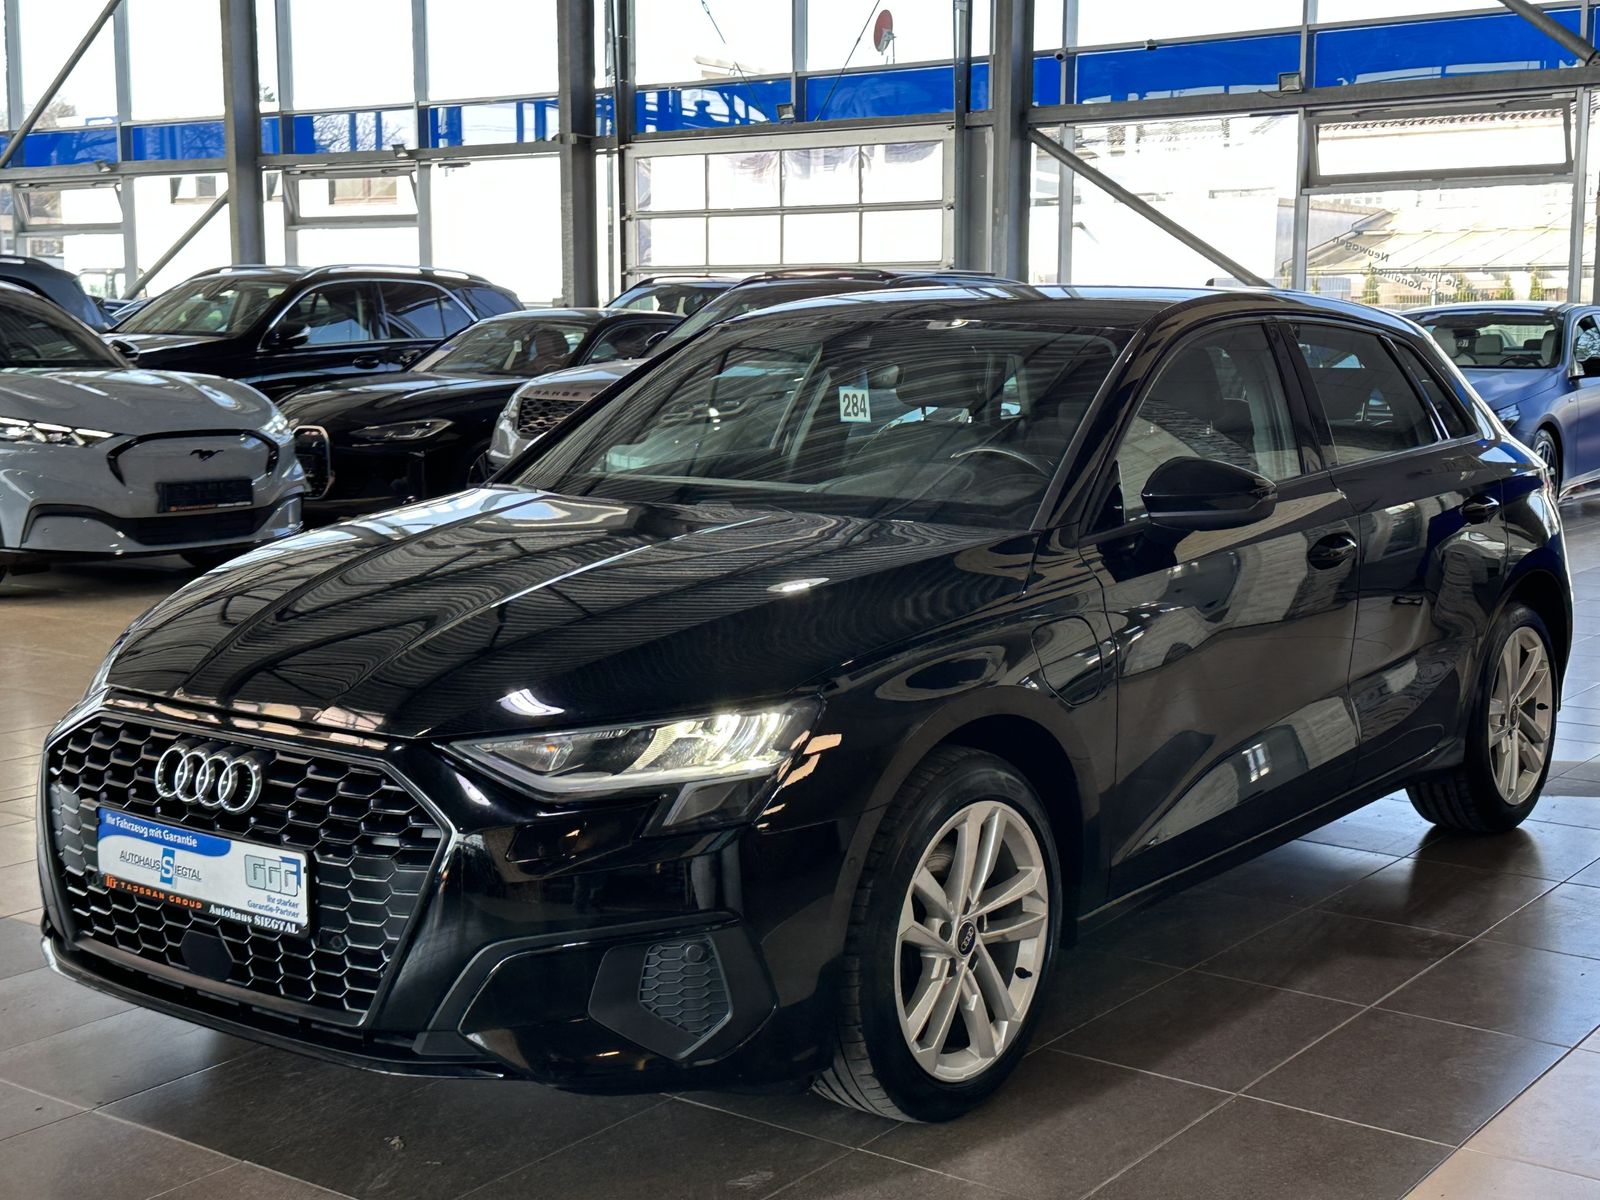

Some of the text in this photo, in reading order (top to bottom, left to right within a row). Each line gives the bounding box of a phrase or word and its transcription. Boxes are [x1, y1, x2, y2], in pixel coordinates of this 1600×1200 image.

[843, 393, 867, 417] 284
[116, 817, 148, 838] Fahrzeug
[149, 827, 162, 839] mit
[163, 830, 198, 847] Garantie
[120, 850, 161, 870] AUTOHAUS
[169, 895, 203, 909] GROUP
[209, 904, 299, 934] Autohaus SIEGTAL
